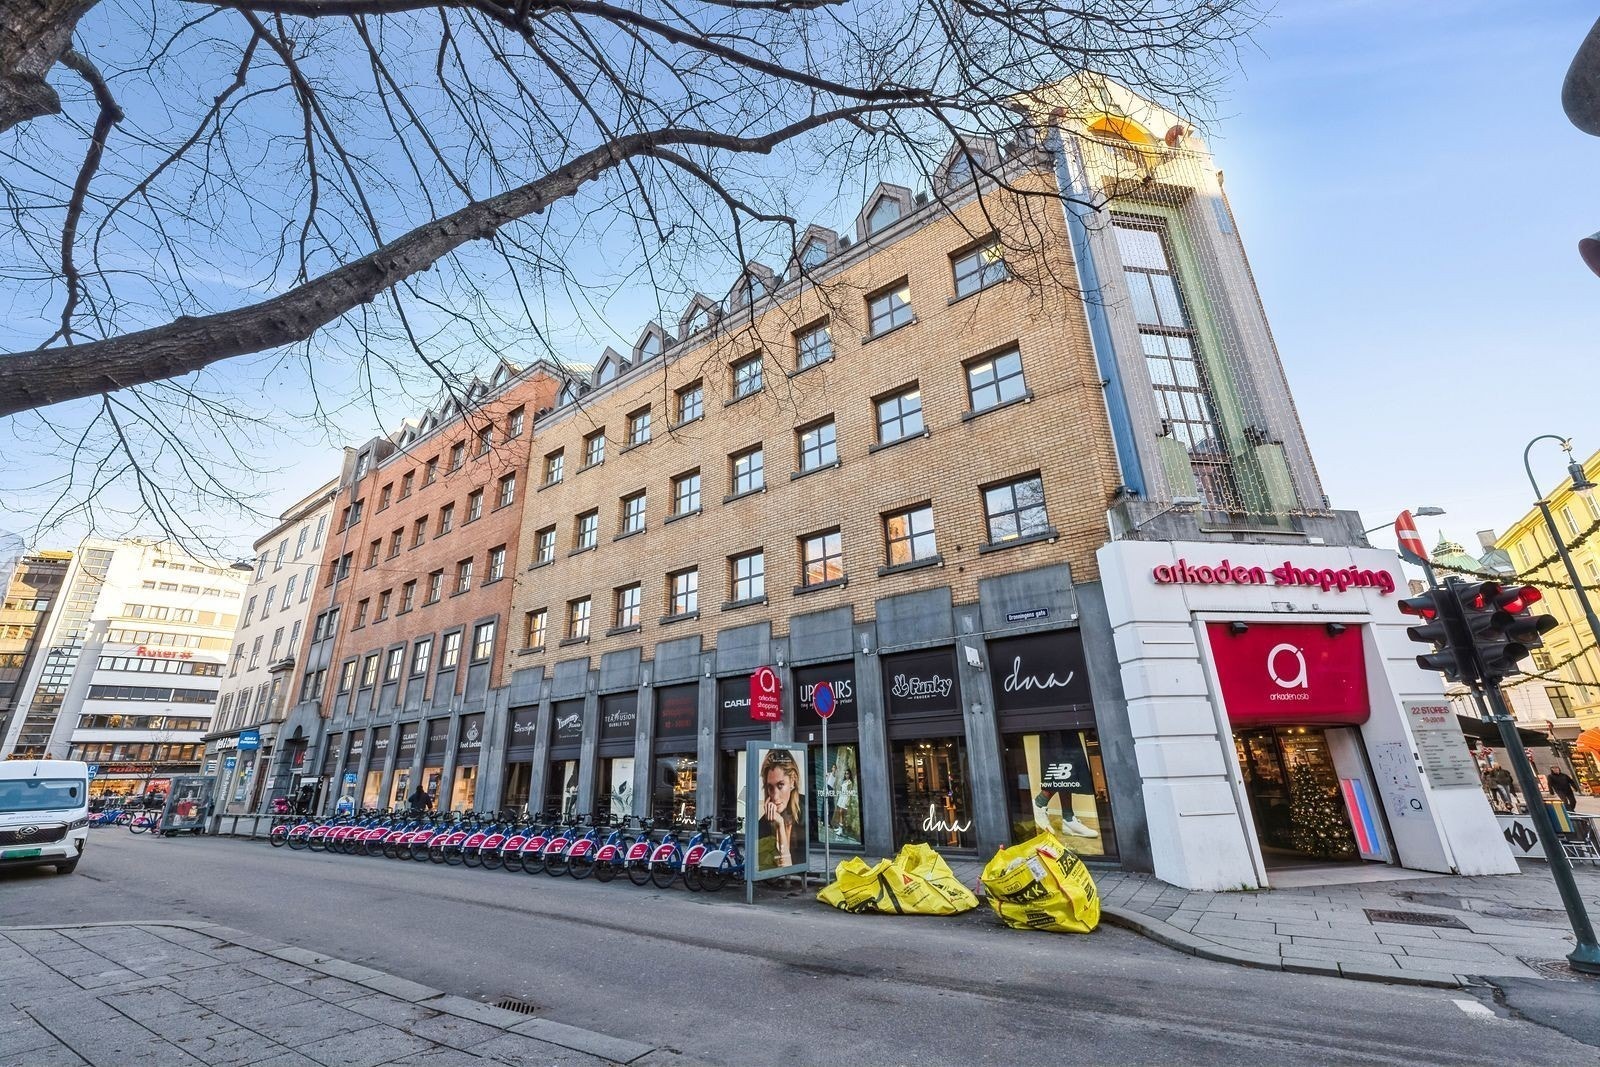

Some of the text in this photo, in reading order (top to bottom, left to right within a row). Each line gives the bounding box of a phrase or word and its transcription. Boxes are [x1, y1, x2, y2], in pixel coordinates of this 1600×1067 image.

[1153, 559, 1396, 594] arkaden shopping
[1009, 612, 1035, 620] Dronningens
[908, 675, 952, 697] Funky
[1270, 692, 1296, 701] arkaden
[758, 702, 778, 711] shopping
[1421, 706, 1450, 714] STORES
